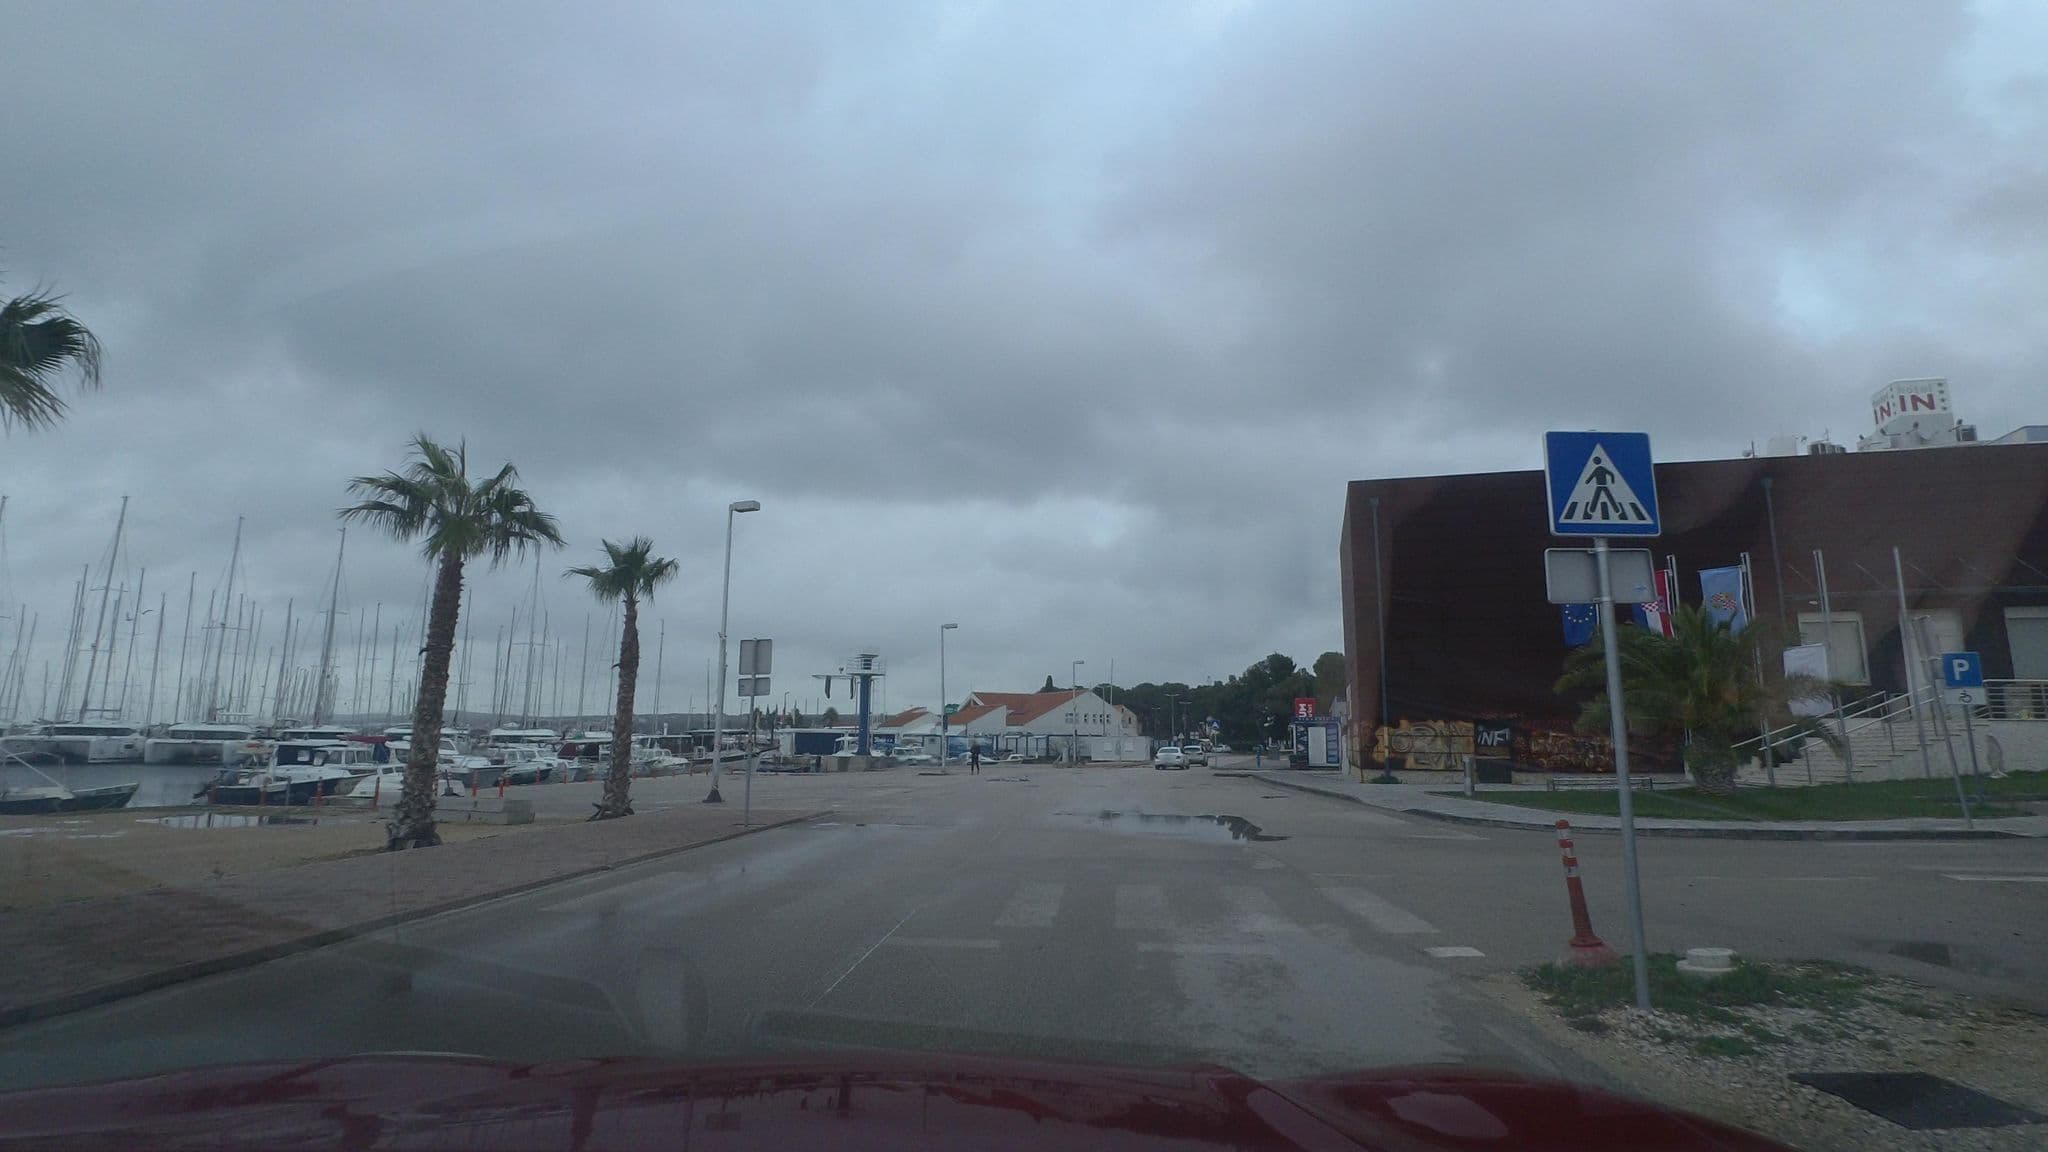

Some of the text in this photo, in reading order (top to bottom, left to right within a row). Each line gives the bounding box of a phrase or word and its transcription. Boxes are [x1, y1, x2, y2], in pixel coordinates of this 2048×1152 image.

[1874, 401, 1892, 424] IN
[1899, 393, 1936, 412] IN
[1952, 659, 1969, 680] P
